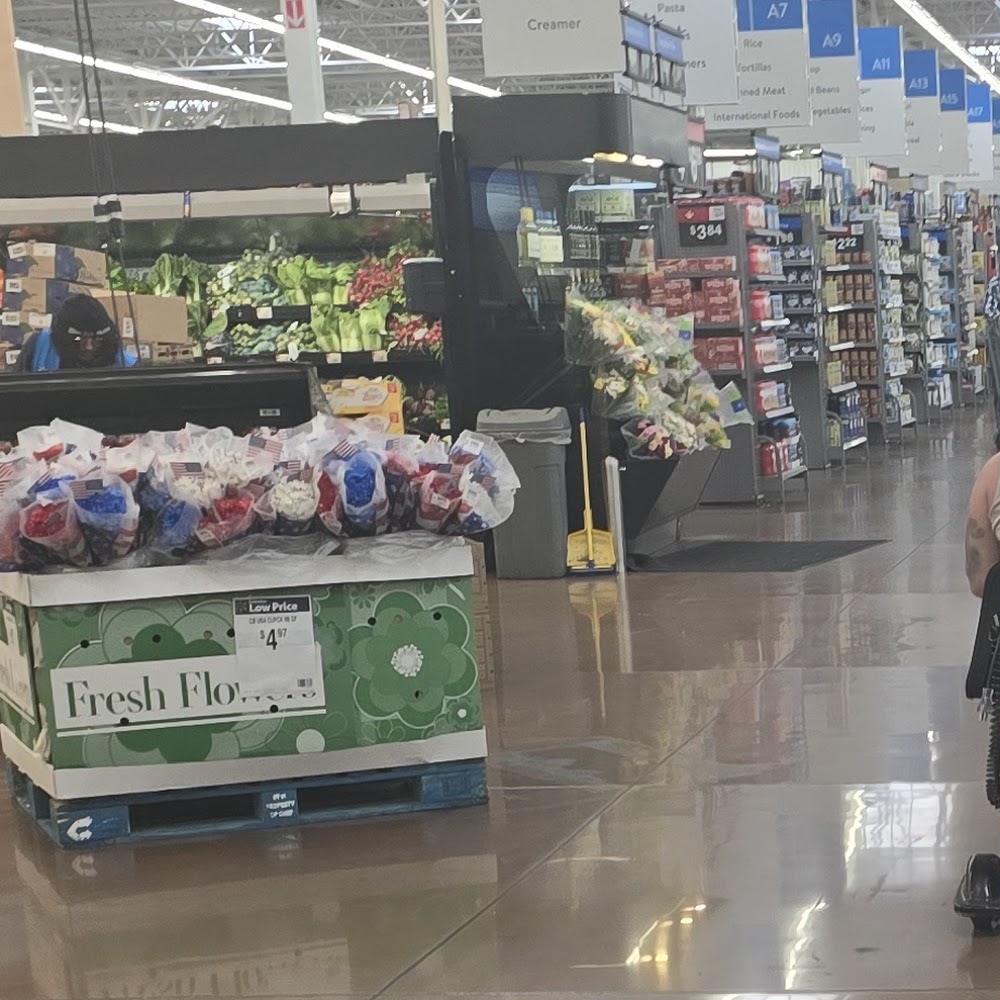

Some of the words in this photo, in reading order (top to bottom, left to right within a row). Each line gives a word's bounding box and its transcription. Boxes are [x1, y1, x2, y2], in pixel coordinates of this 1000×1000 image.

[657, 3, 685, 13] Pasta
[767, 2, 788, 20] A7
[527, 18, 582, 31] Creamer
[743, 38, 763, 48] Rice
[822, 32, 842, 48] A9
[872, 57, 891, 71] A11
[816, 86, 840, 94] Beans
[909, 77, 928, 90] A13
[763, 86, 786, 96] Meat
[713, 109, 771, 122] International
[773, 109, 800, 119] Foods
[812, 106, 851, 117] egetables
[249, 603, 271, 612] Low
[272, 601, 298, 611] Price
[64, 675, 167, 719] Fresh
